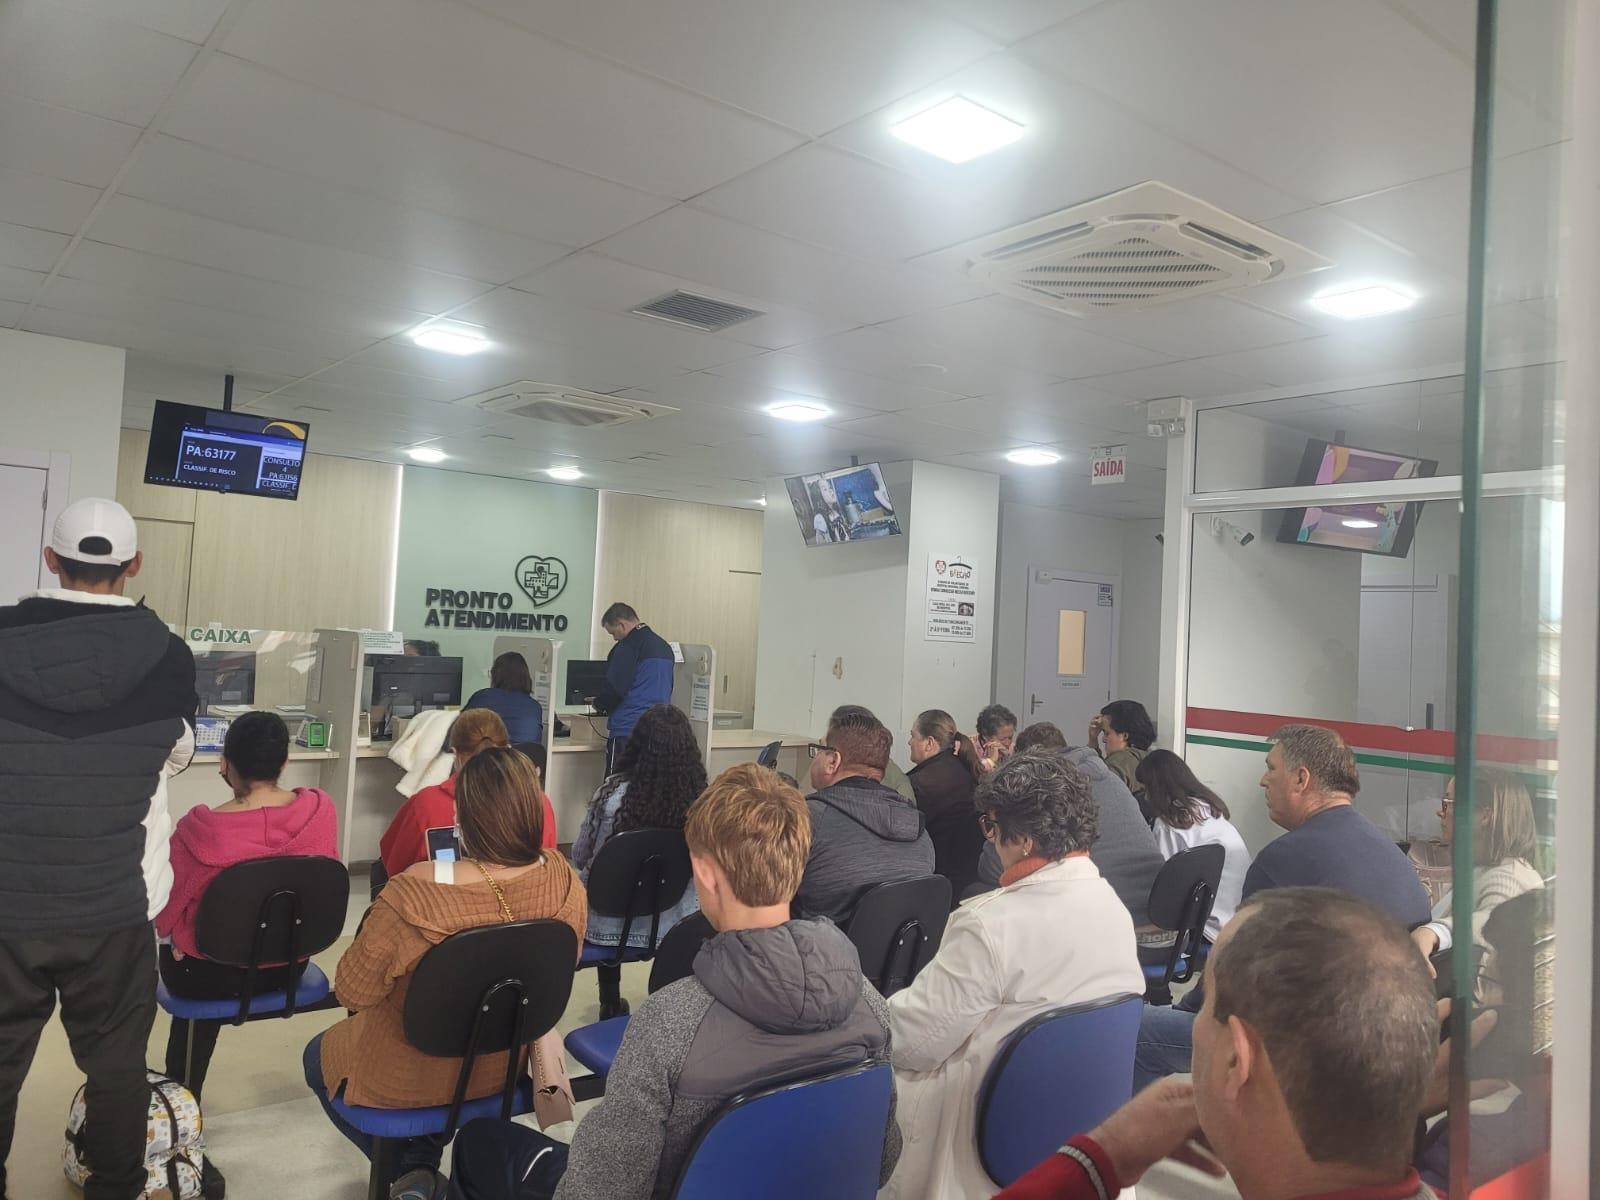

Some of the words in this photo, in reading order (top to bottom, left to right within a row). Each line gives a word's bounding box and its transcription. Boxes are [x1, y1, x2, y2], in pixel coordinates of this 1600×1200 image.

[186, 445, 237, 461] PA:63177
[218, 468, 236, 476] RISCO
[1093, 458, 1124, 477] SAÍDA
[425, 588, 513, 610] PRONTO
[424, 608, 569, 633] ATENDIMENTO
[190, 628, 251, 643] CAIXA
